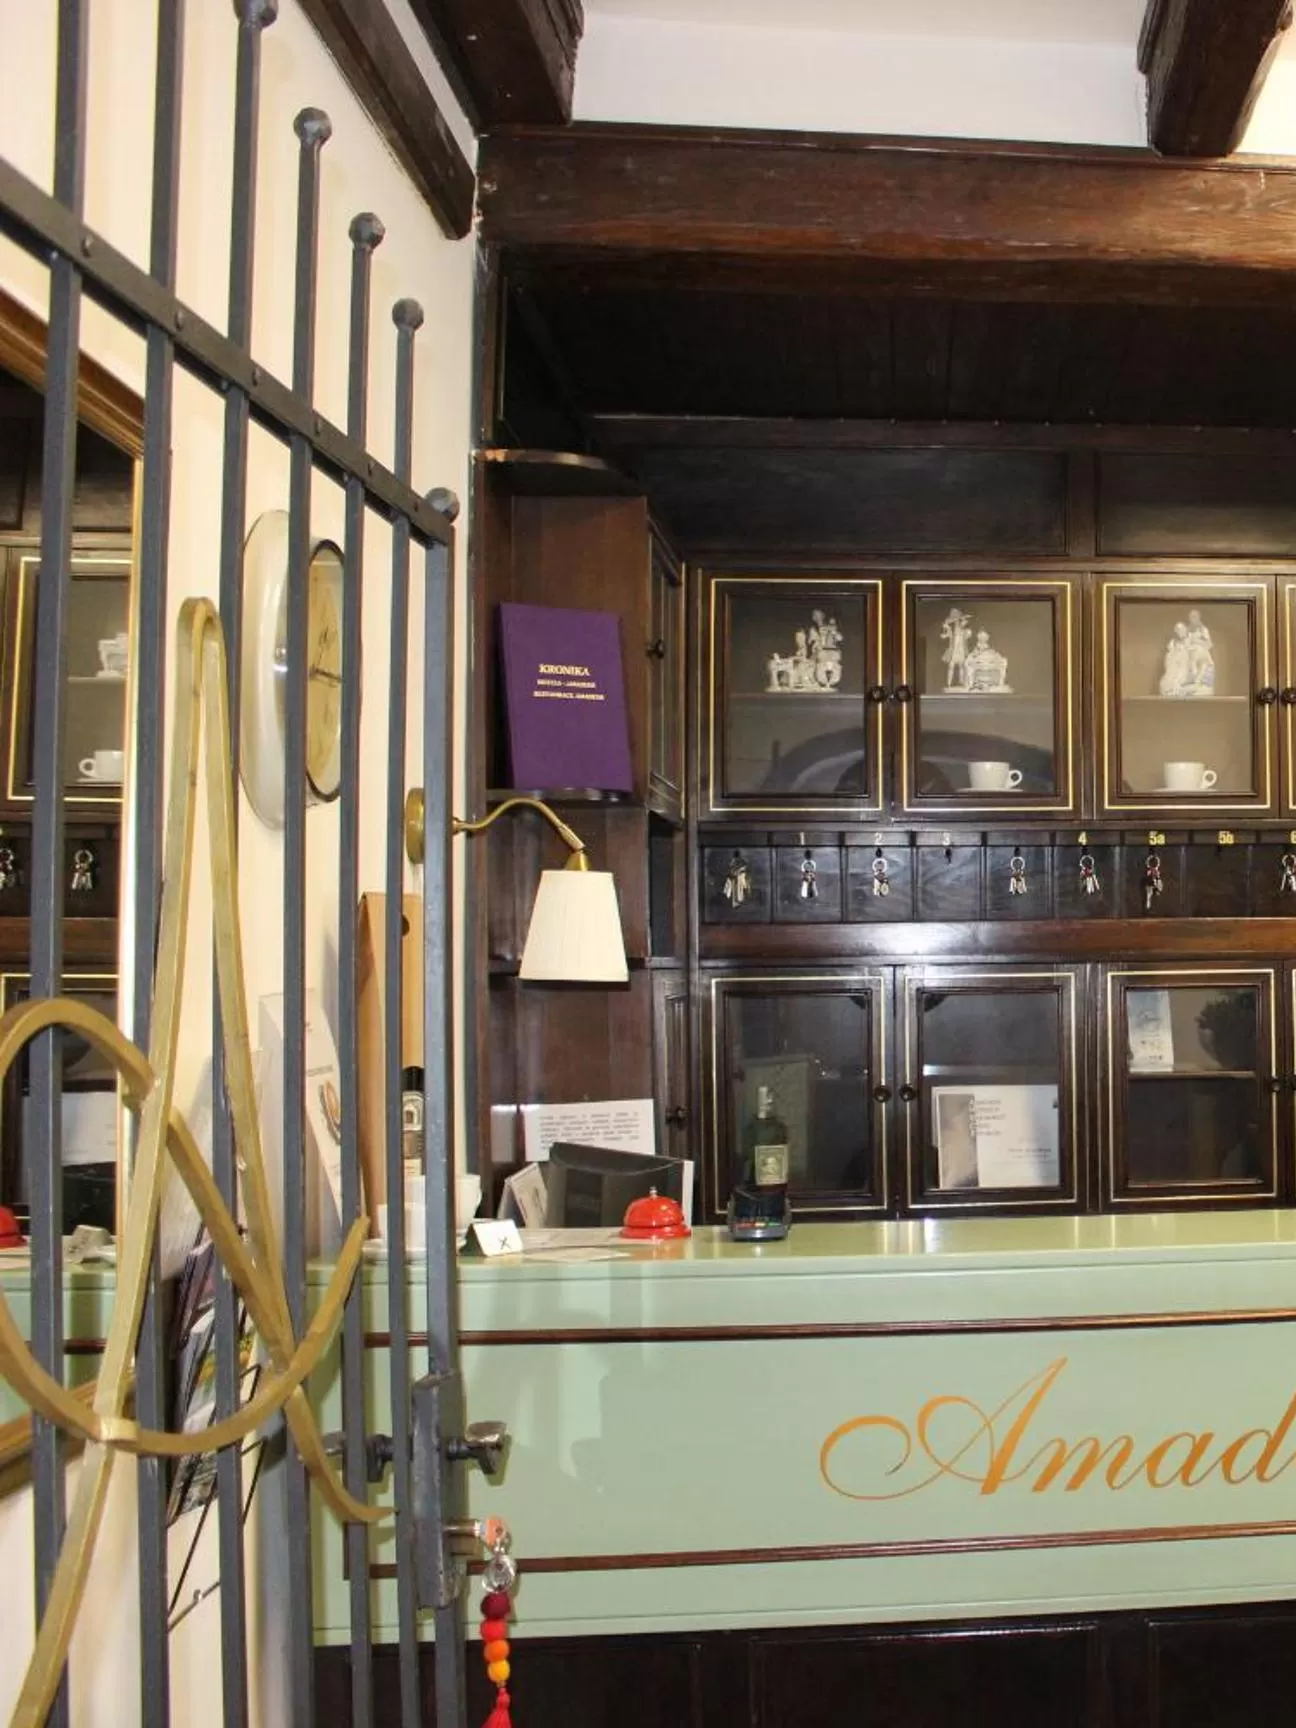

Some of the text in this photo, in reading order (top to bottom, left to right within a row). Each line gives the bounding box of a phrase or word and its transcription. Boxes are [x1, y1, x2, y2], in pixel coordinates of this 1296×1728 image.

[538, 663, 591, 676] KRONIKA
[874, 832, 883, 845] 2
[942, 832, 951, 845] 3
[1078, 831, 1087, 845] 4
[1148, 831, 1166, 845] 5a
